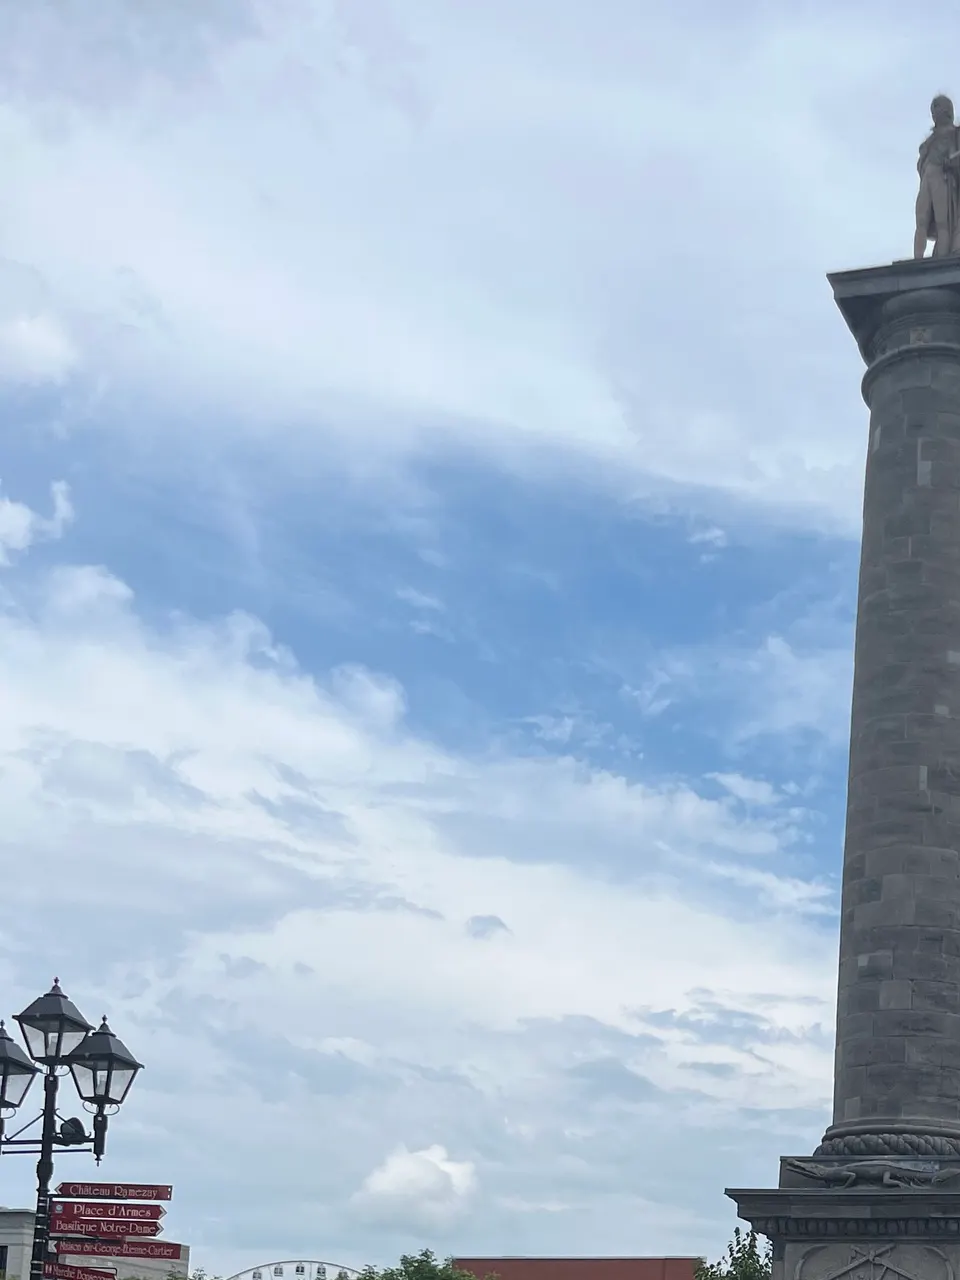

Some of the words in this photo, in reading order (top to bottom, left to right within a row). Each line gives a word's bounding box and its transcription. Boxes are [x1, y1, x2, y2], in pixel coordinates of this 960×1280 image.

[69, 1184, 110, 1196] Château
[114, 1185, 158, 1199] Ramezay
[73, 1204, 104, 1215] Place
[108, 1205, 151, 1217] d'Armes
[55, 1220, 97, 1234] Basilique
[100, 1221, 156, 1234] Notre-Dame
